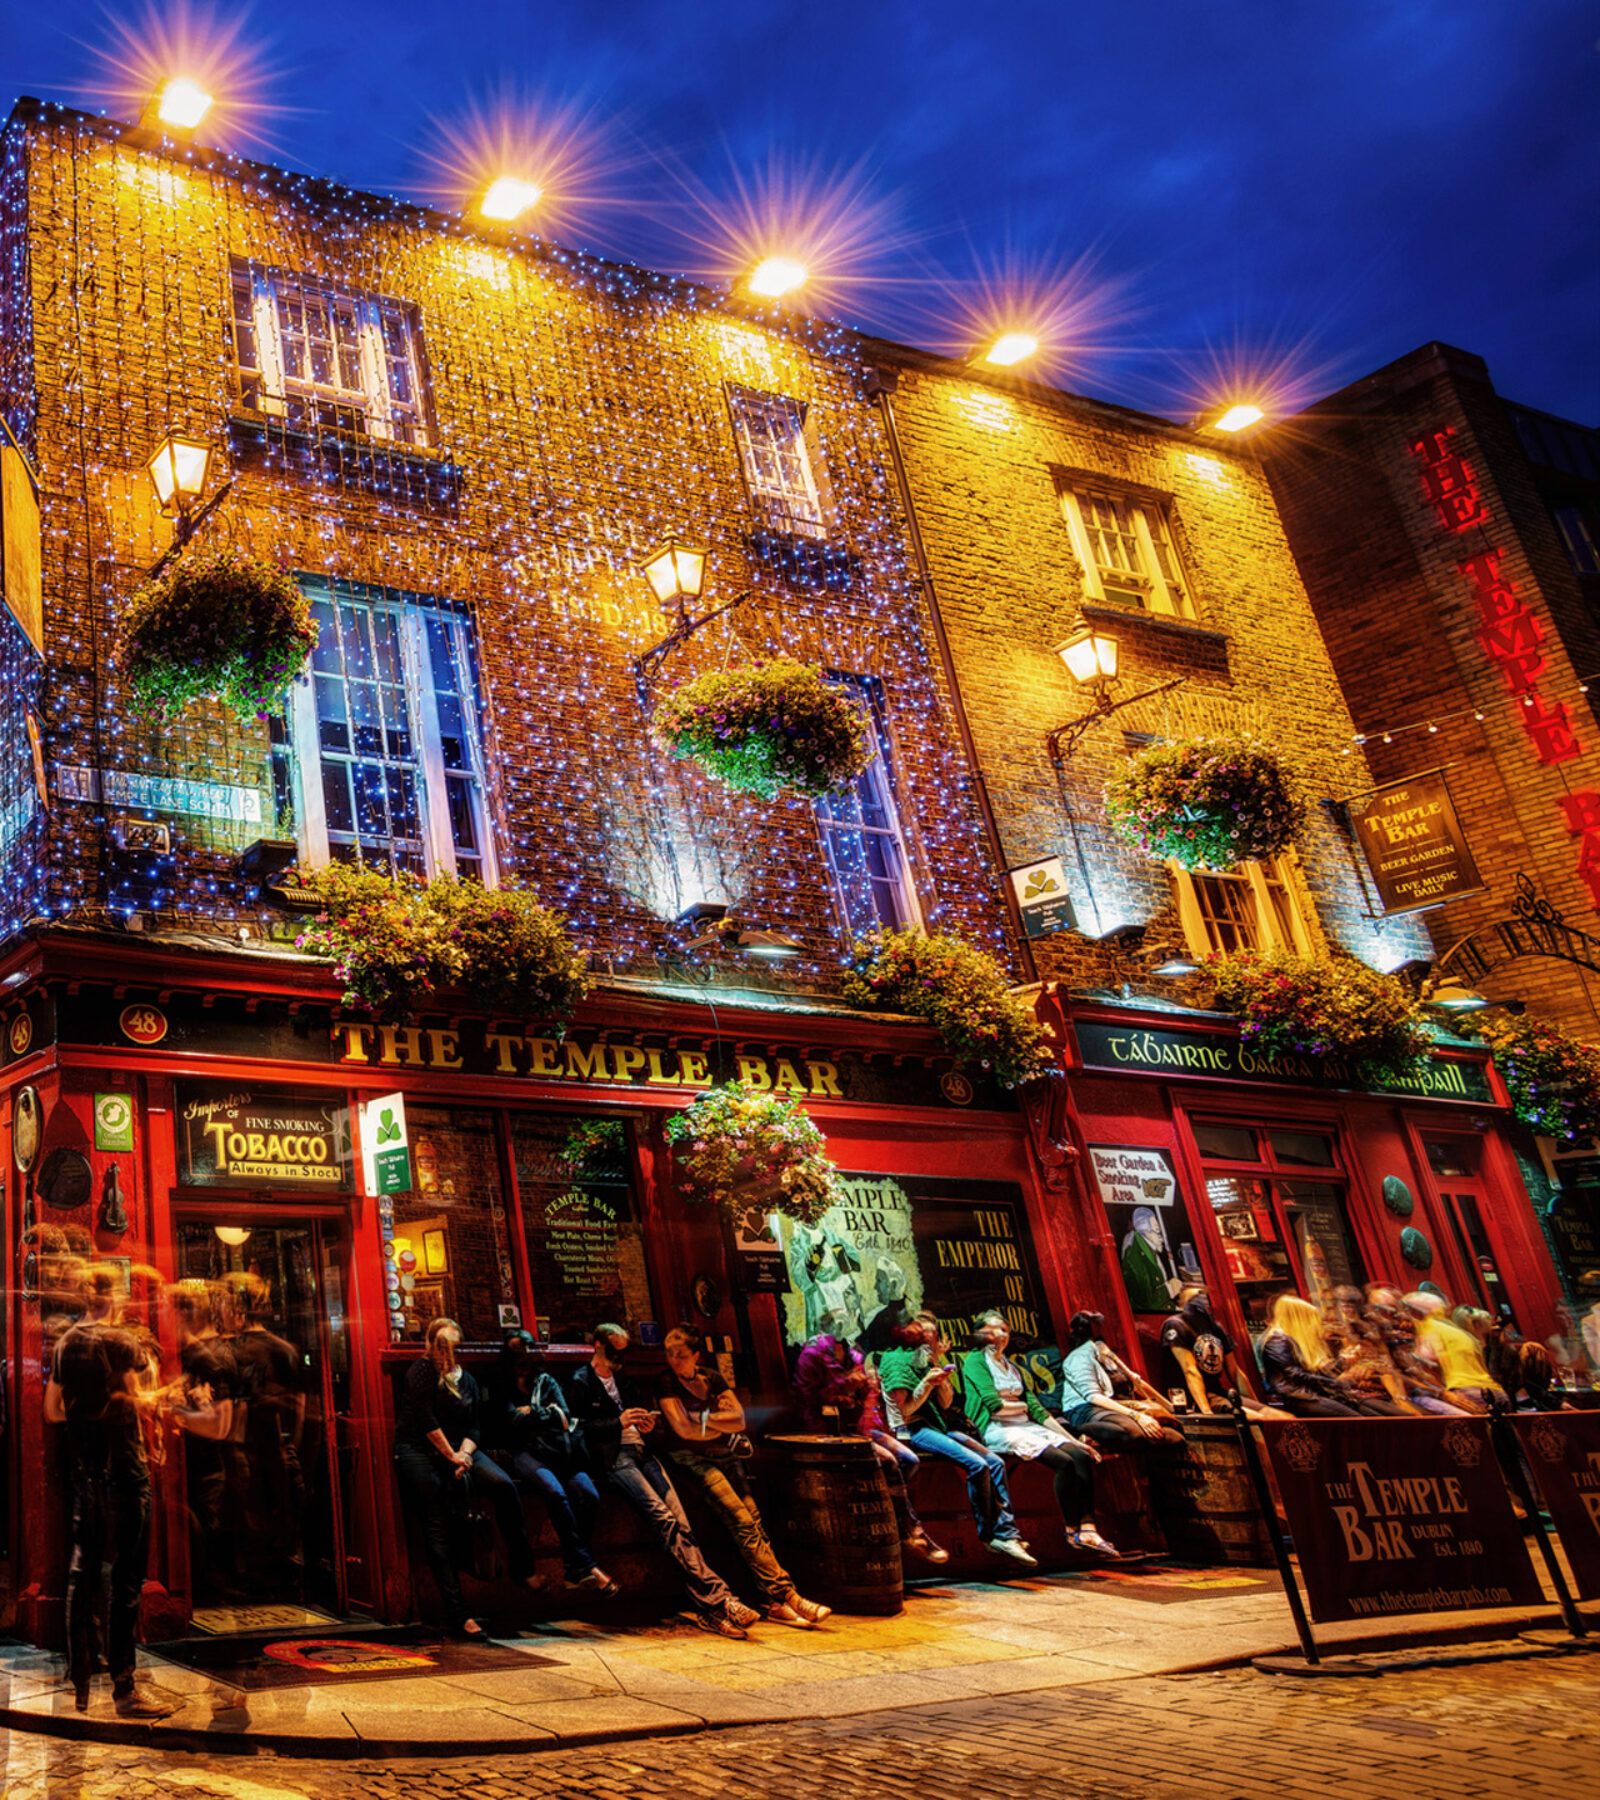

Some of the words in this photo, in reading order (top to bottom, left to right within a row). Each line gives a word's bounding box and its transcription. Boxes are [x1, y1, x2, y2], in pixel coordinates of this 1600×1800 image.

[1409, 425, 1485, 532] THE
[1461, 549, 1580, 766] TEMPLE
[104, 789, 147, 805] EMPLE
[152, 794, 186, 810] LANE
[1383, 790, 1410, 806] THE
[1364, 800, 1443, 834] TEMPLE
[1385, 821, 1431, 845] BAR
[1380, 856, 1409, 872] BEER
[1410, 844, 1456, 864] GARDEN
[1395, 880, 1421, 895] LIVE
[1422, 870, 1459, 888] MUSIC
[1413, 883, 1446, 898] DAILY
[13, 1019, 29, 1047] 48
[127, 1009, 158, 1034] 48
[331, 1022, 464, 1070] THE
[484, 1032, 714, 1089] TEMPLE
[735, 1054, 844, 1099] BAR
[184, 1092, 252, 1122] Importers
[226, 1109, 240, 1119] OF
[245, 1117, 272, 1130] FINE
[273, 1118, 326, 1133] SMOKING
[203, 1121, 328, 1170] TOBACCO
[231, 1161, 279, 1177] Always
[285, 1165, 297, 1177] in
[301, 1165, 340, 1179] Stock
[1093, 1152, 1118, 1169] Beer
[1118, 1153, 1157, 1172] Garden
[1097, 1170, 1142, 1189] Smoking
[545, 1192, 590, 1216] TEMPLE
[593, 1197, 617, 1220] BAR
[836, 1187, 906, 1211] MPLE
[1111, 1186, 1137, 1202] Area
[843, 1209, 891, 1236] BAR
[973, 1210, 1014, 1239] THE
[934, 1239, 1021, 1271] EMPEROR
[1003, 1274, 1025, 1303] OF
[1324, 1481, 1356, 1500] THE
[1346, 1461, 1469, 1518] TEMPLE
[1331, 1505, 1417, 1563] BAR
[1410, 1523, 1455, 1540] DUBLIN
[1433, 1541, 1455, 1558] Est.
[1458, 1539, 1484, 1556] 1840
[1347, 1585, 1513, 1614] www.thetemplebarpub.com
